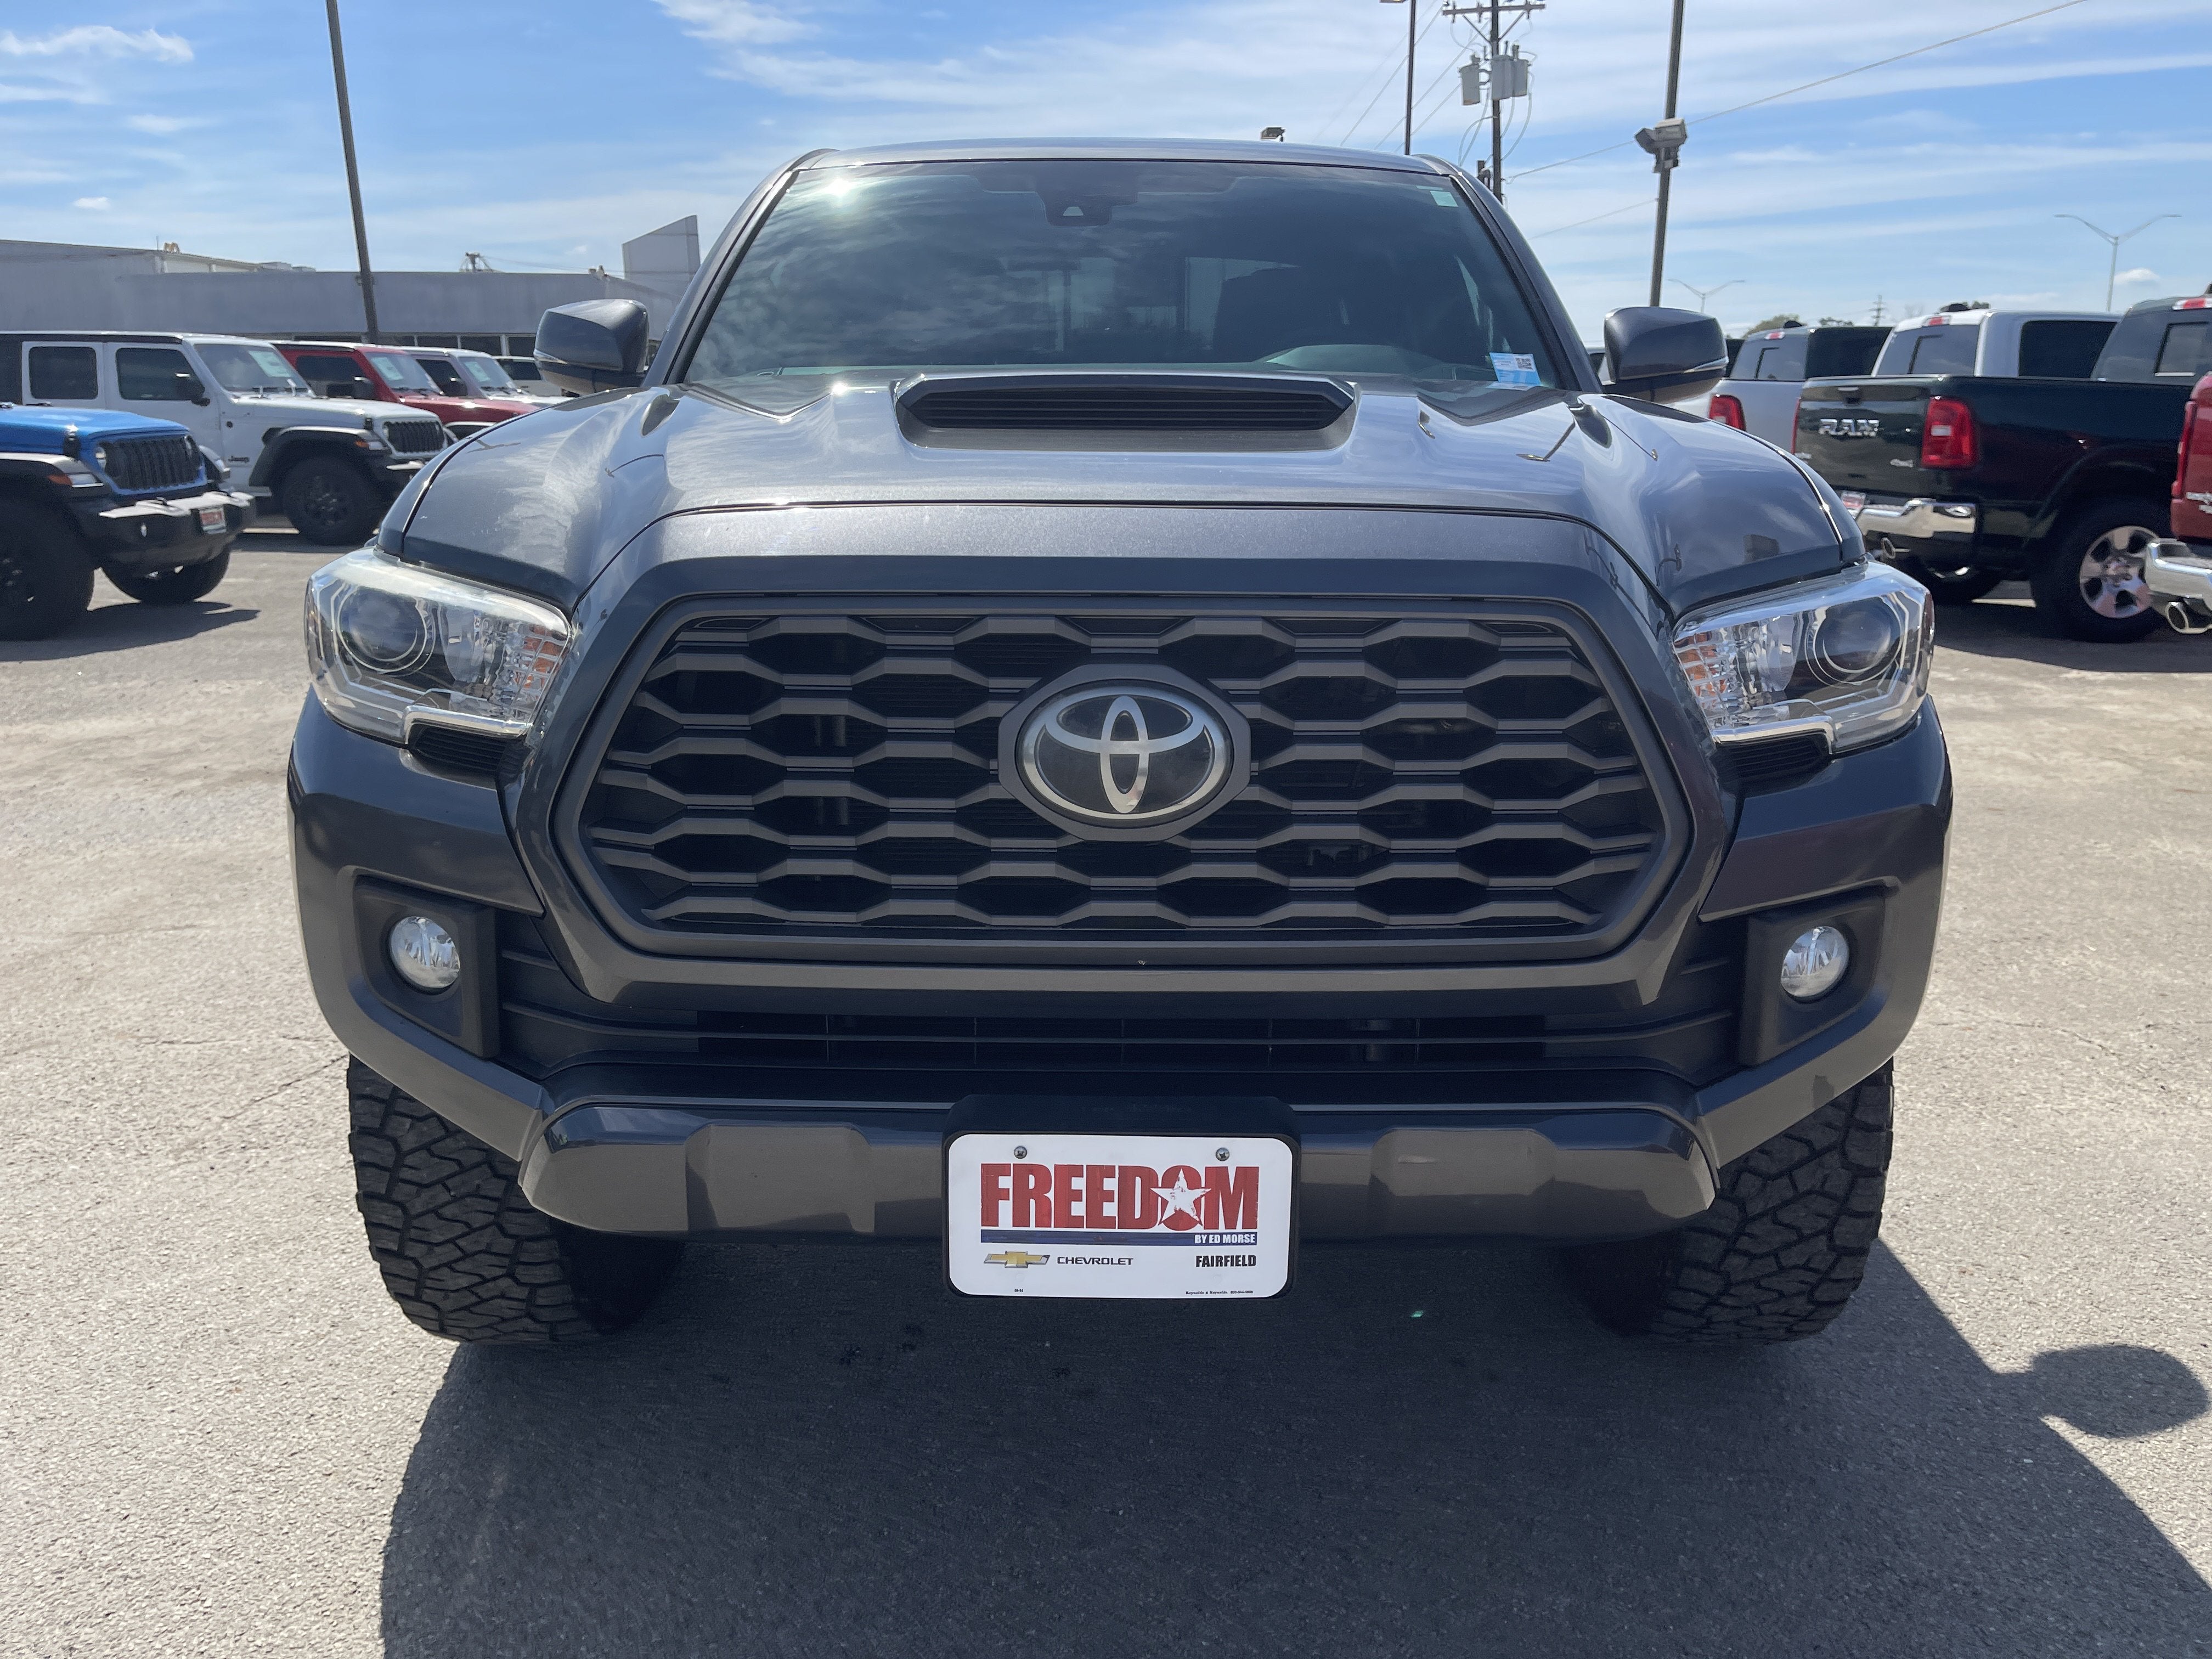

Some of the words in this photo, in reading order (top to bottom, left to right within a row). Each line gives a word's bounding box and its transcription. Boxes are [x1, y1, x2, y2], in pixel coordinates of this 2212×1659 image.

[1818, 419, 1880, 437] RAM
[981, 1163, 1260, 1231] FREEDOM
[1194, 1234, 1207, 1244] BY
[1209, 1234, 1221, 1244] ED
[1222, 1234, 1255, 1243] MORSE
[1057, 1256, 1134, 1265] CHEVROLET
[1196, 1255, 1256, 1267] FAIRFIELD
